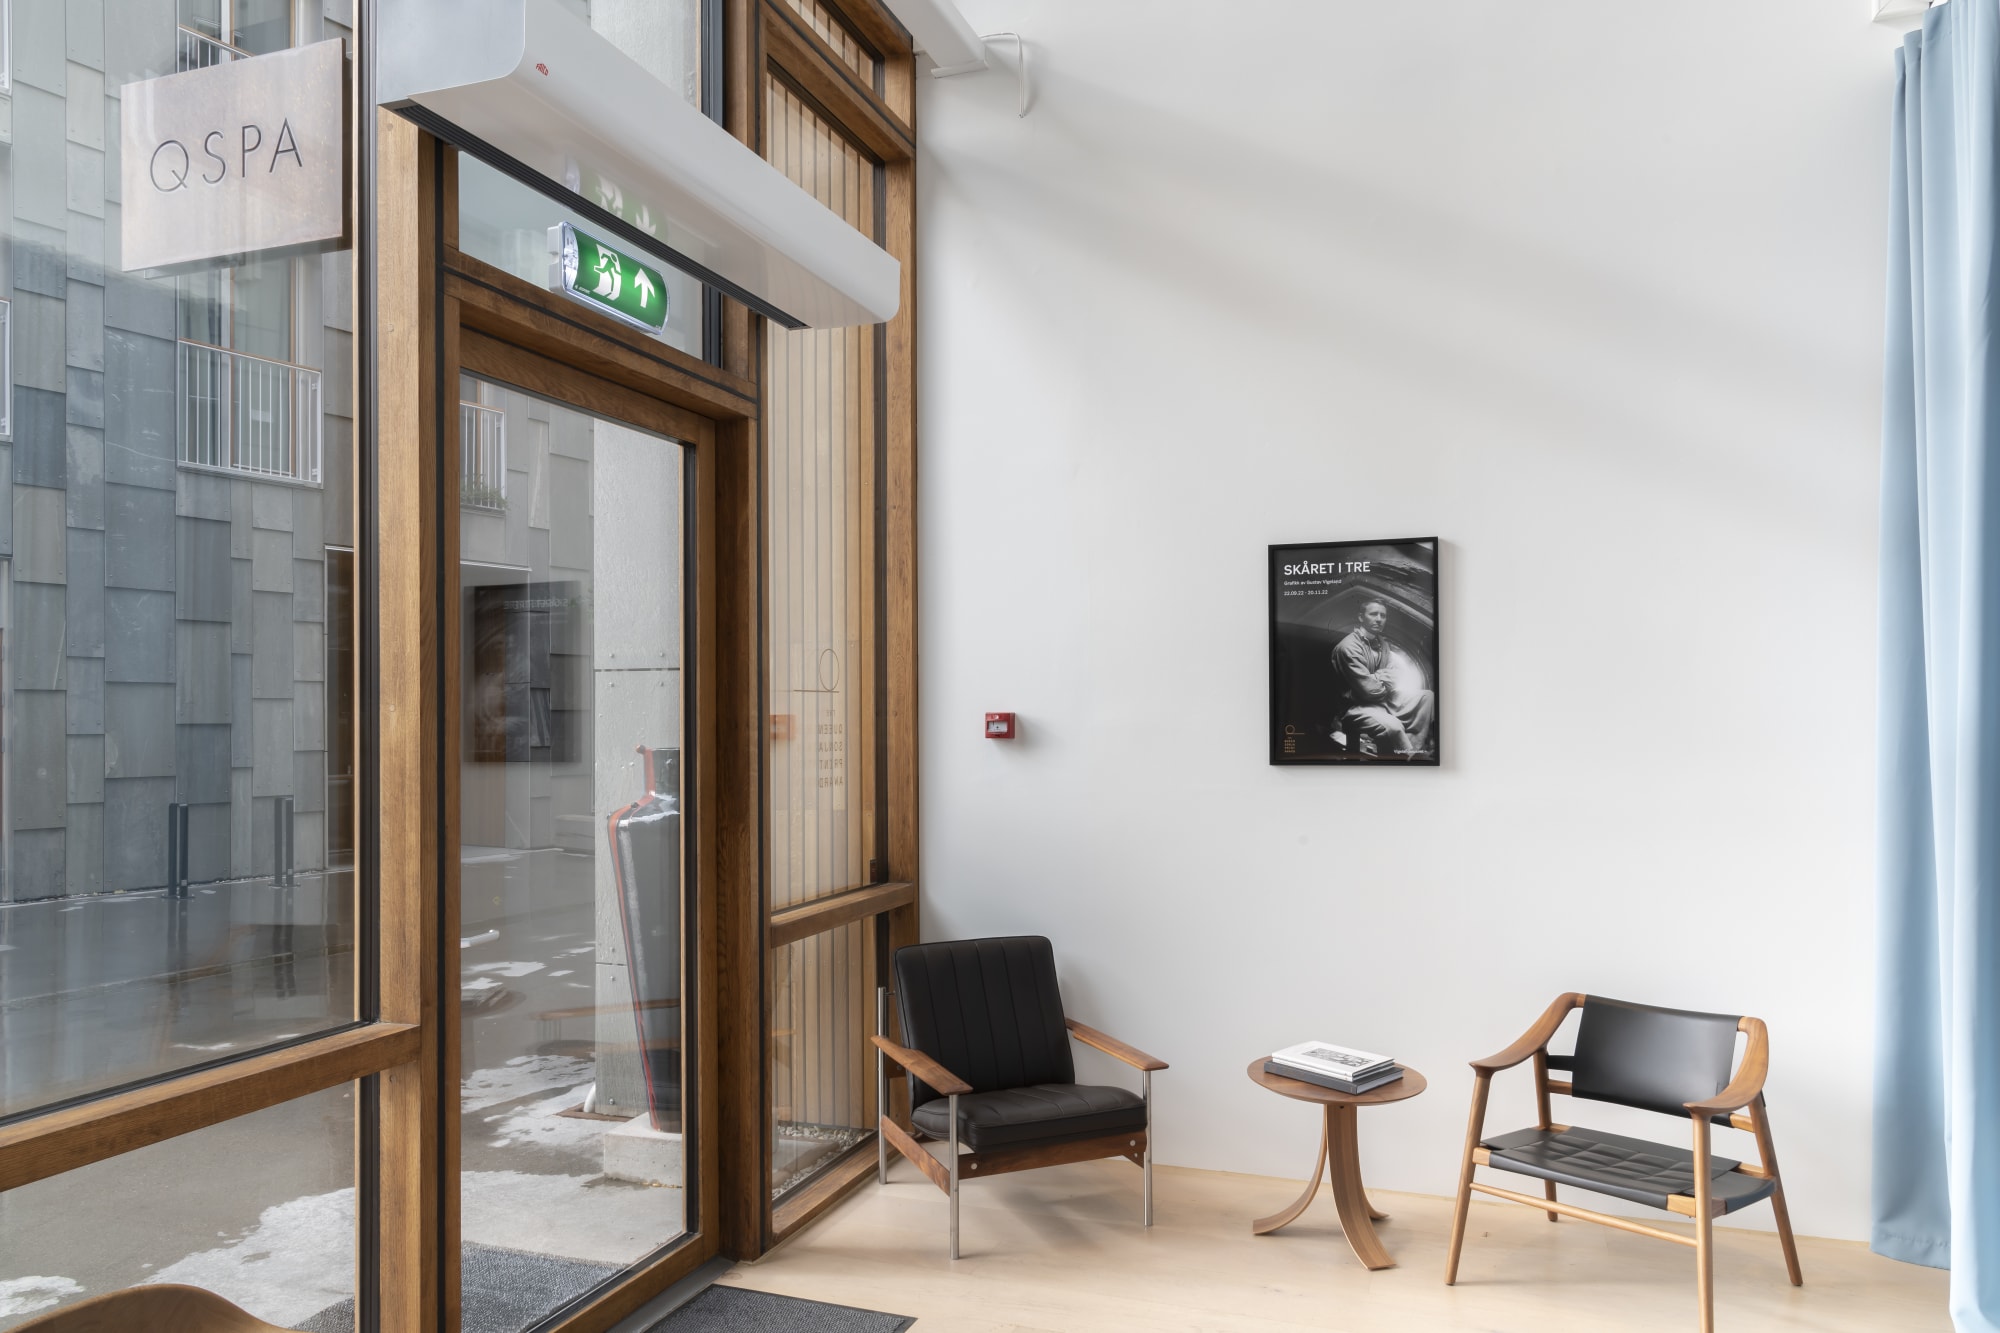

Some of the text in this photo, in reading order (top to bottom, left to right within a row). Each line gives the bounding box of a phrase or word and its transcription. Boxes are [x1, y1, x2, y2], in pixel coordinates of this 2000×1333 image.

[150, 118, 302, 192] QSPA
[1284, 560, 1335, 576] SKÅRET
[1345, 561, 1371, 573] TRE
